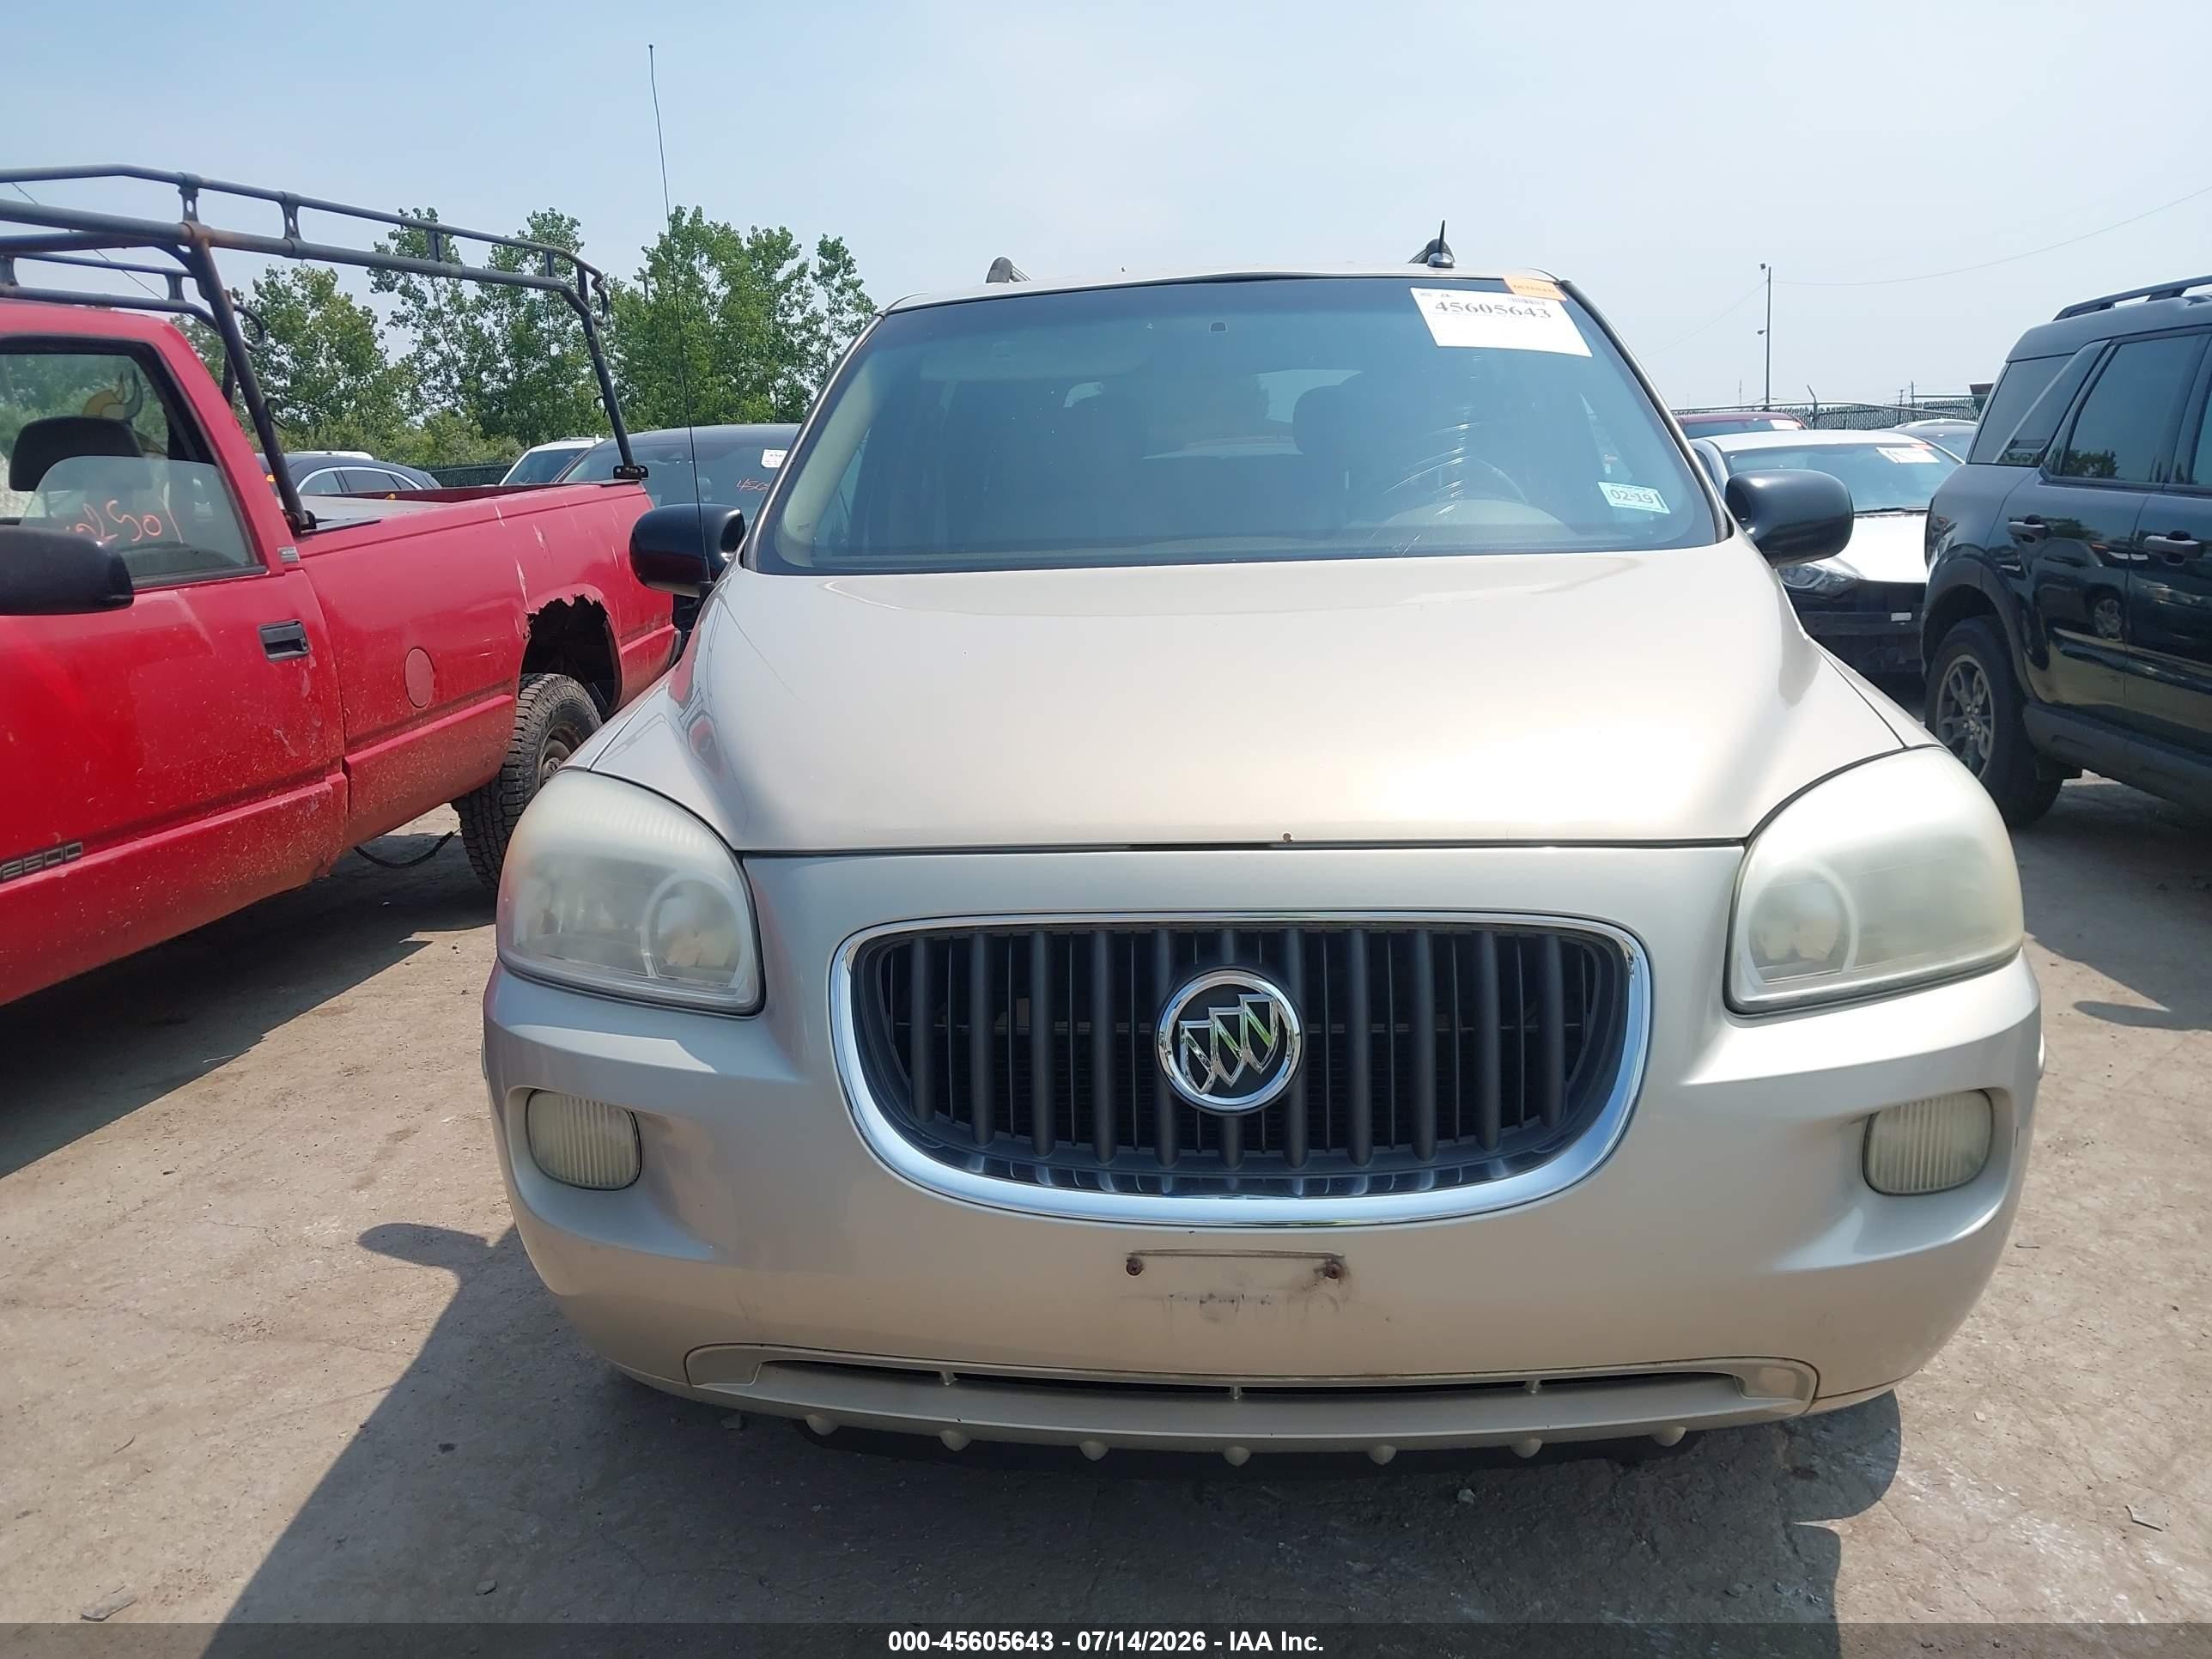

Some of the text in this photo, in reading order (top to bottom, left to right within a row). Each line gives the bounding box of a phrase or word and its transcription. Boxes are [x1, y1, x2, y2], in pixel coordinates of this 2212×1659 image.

[1435, 301, 1552, 319] 45605643
[1610, 489, 1654, 504] 02-19
[0, 842, 83, 880] 2500
